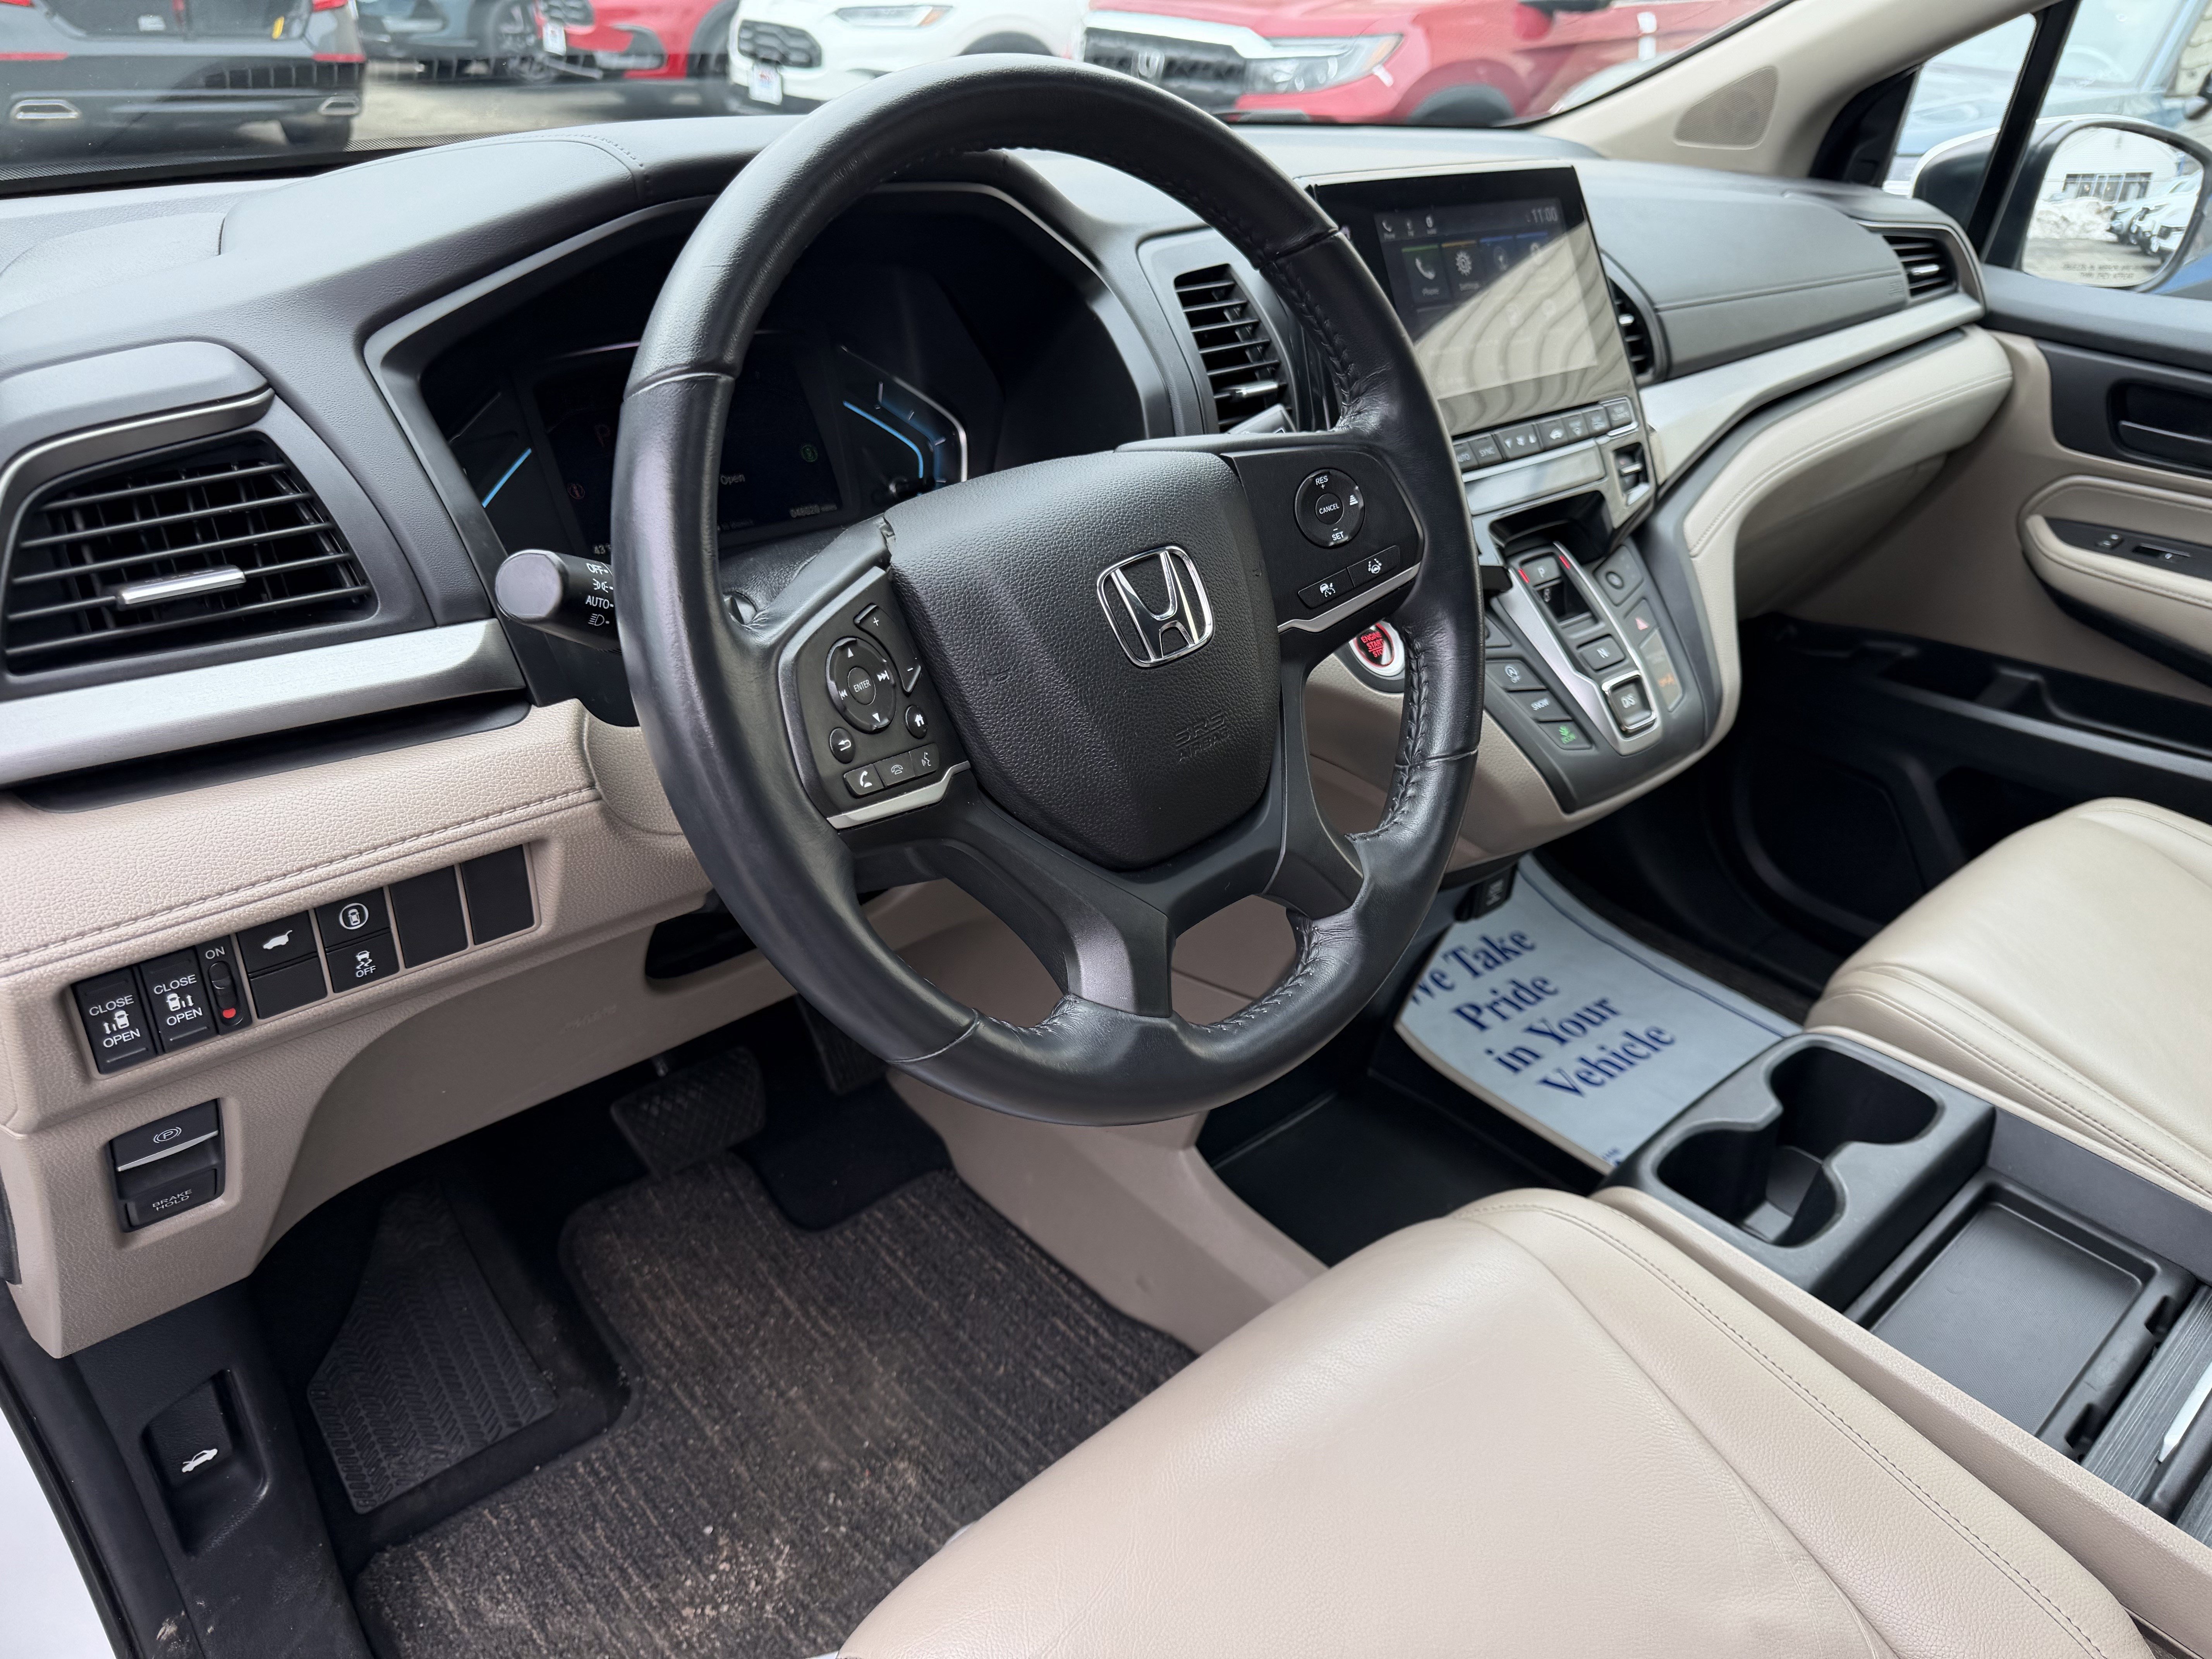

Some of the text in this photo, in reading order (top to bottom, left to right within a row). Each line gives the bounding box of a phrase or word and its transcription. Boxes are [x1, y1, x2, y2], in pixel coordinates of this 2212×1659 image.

[1315, 475, 1329, 485] RES
[1319, 503, 1340, 514] CANCEL
[1331, 531, 1344, 541] SET
[586, 563, 603, 575] OFF
[1537, 566, 1545, 578] P
[585, 595, 610, 609] AUTO
[1360, 630, 1382, 643] ENGINE
[1366, 639, 1384, 650] START
[1372, 649, 1384, 658] STO
[853, 679, 871, 692] ENTER
[205, 946, 225, 960] ON
[1441, 930, 1537, 977] Take
[356, 965, 376, 978] OFF
[153, 974, 197, 994] CLOSE
[89, 994, 134, 1016] CLOSE
[1450, 976, 1559, 1032] Pride
[166, 1007, 203, 1026] OPEN
[103, 1028, 141, 1048] OPEN
[1484, 997, 1623, 1074] in Your
[1537, 1026, 1676, 1097] Vehicle
[152, 1189, 193, 1207] BRAKE
[156, 1195, 190, 1211] HOLD
